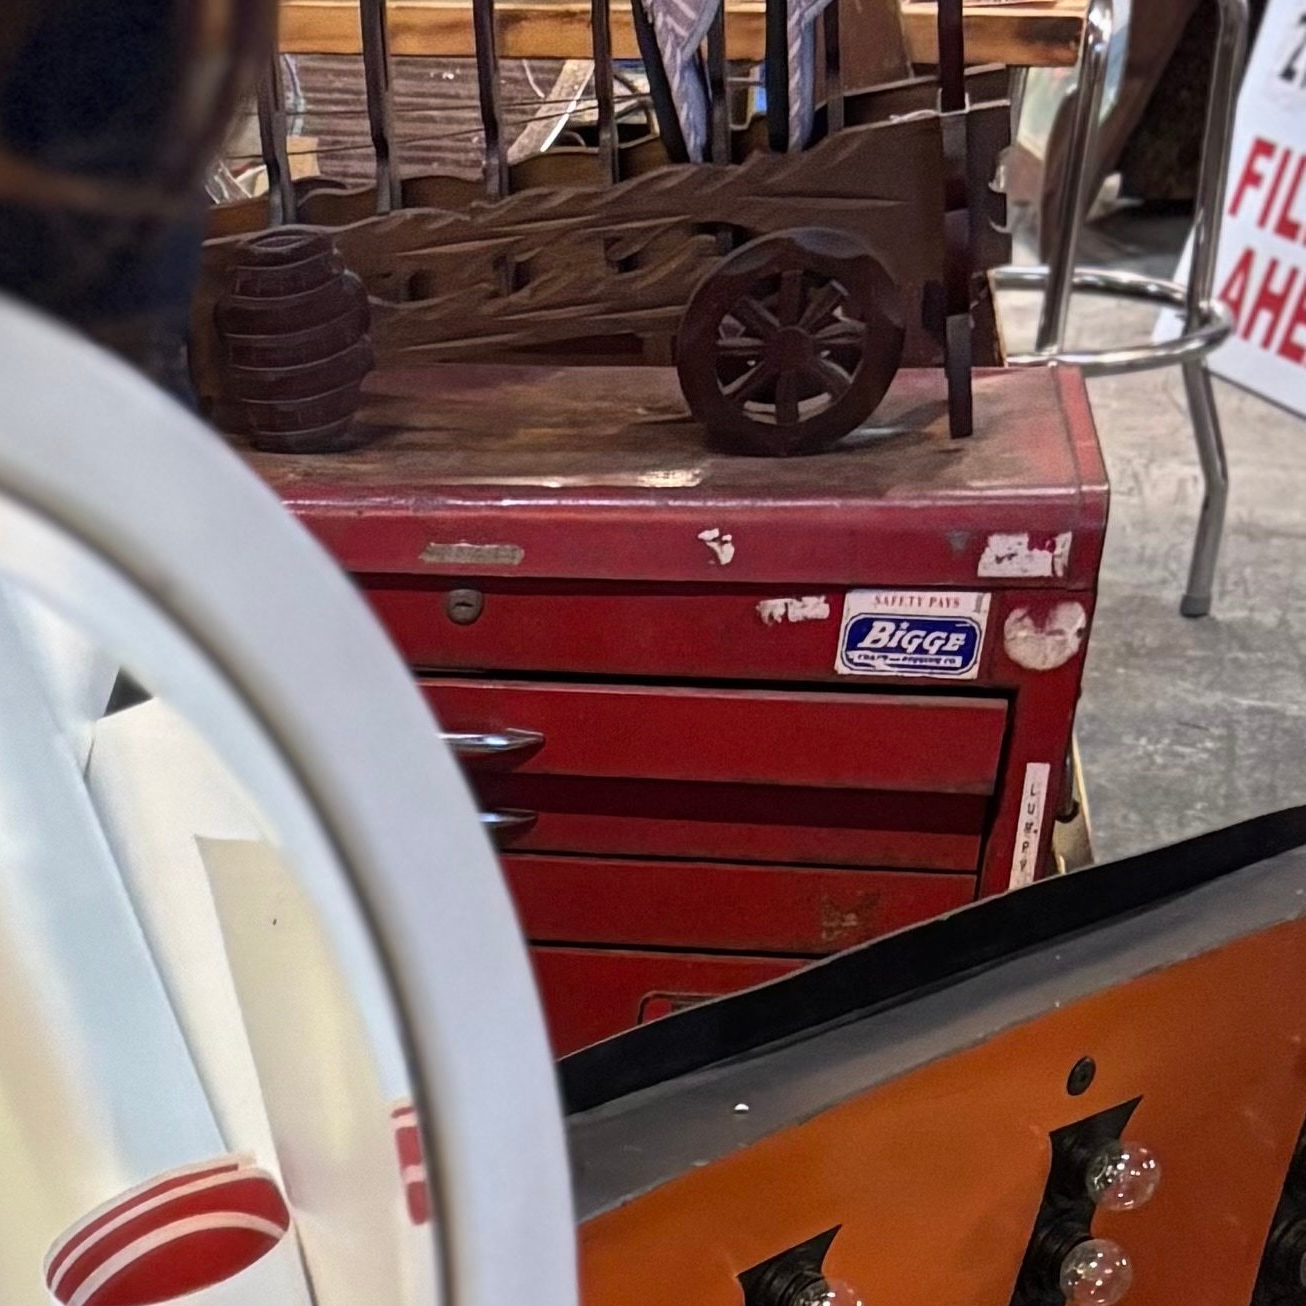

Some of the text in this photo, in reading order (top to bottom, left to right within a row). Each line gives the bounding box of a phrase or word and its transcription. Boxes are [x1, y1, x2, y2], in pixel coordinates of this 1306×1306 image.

[1227, 137, 1306, 247] FIL
[875, 595, 960, 608] SAFETY PAYS
